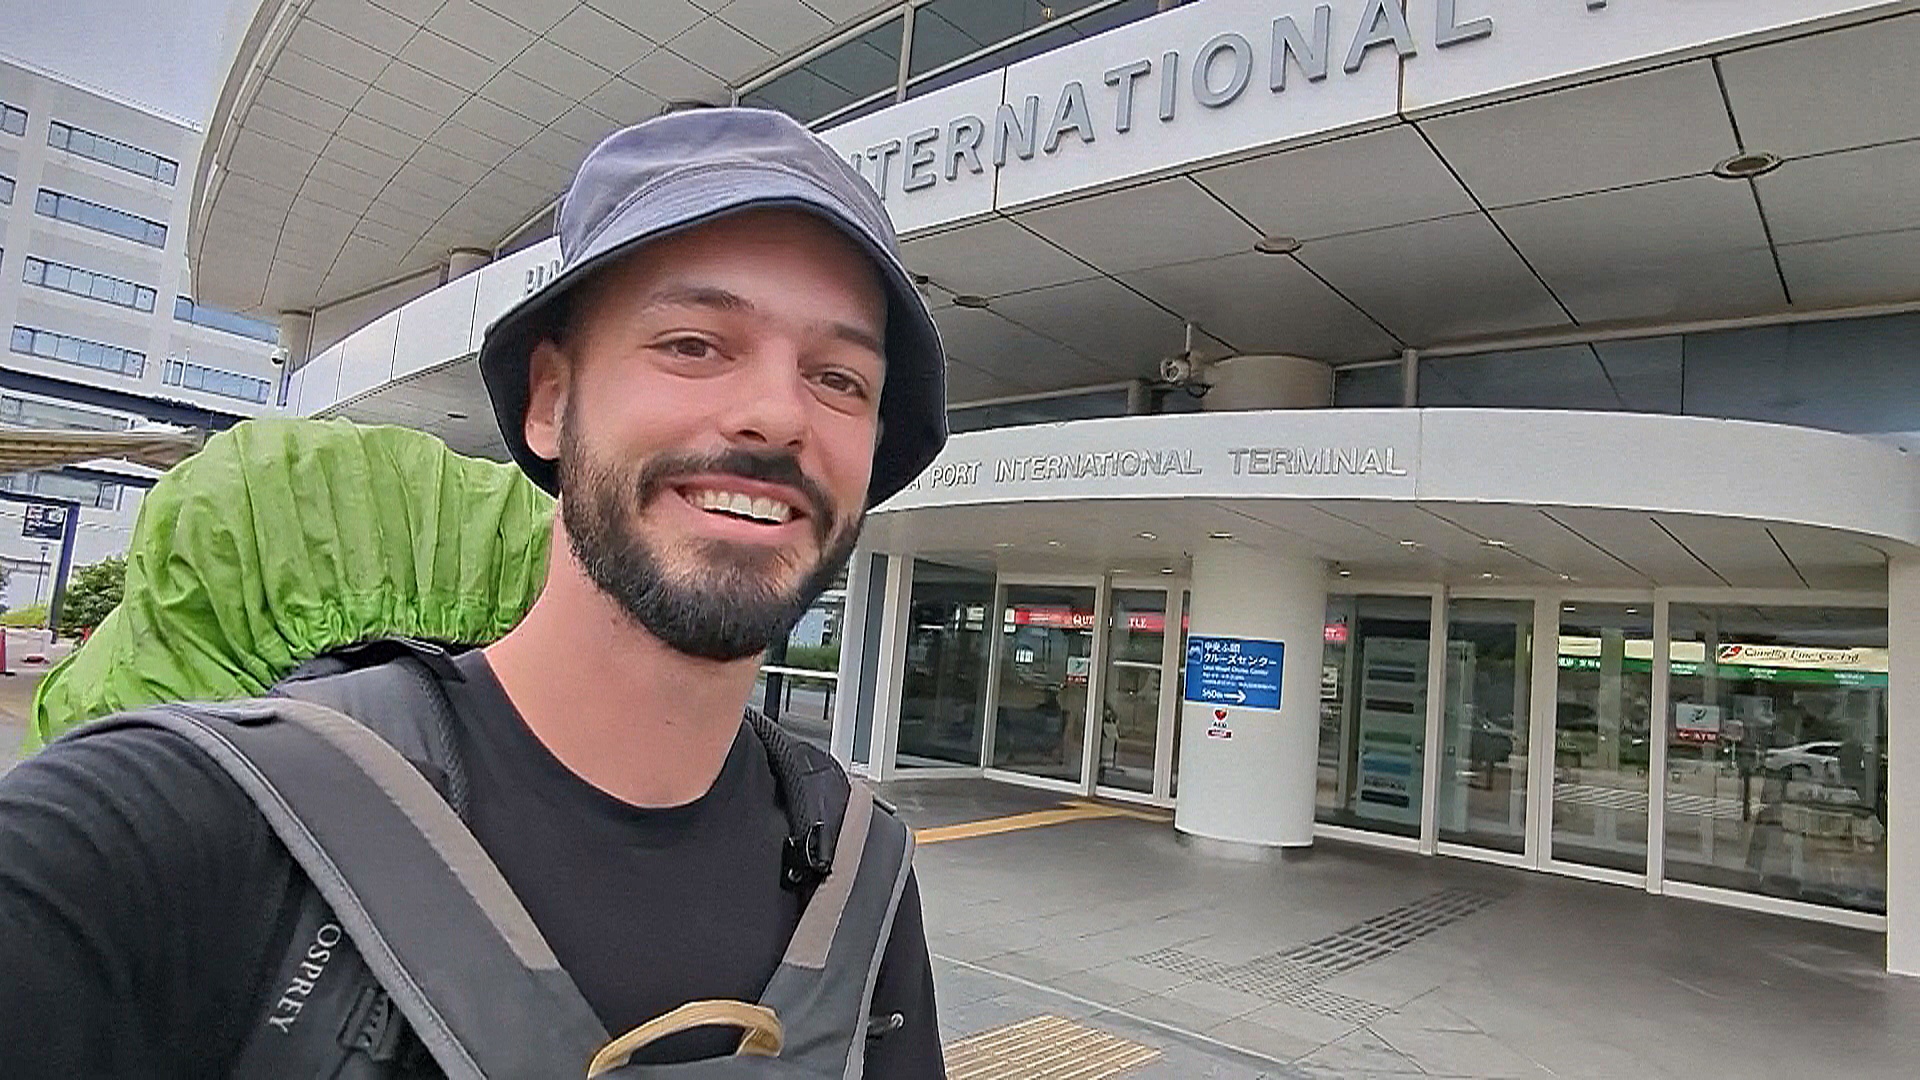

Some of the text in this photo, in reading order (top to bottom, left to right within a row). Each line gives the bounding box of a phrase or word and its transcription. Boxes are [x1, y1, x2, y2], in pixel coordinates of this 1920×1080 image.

[850, 0, 1493, 199] TERNATIONAL
[930, 461, 981, 489] PORT
[994, 449, 1202, 484] INTERNATIONAL
[1228, 445, 1407, 476] TERMINAL
[1203, 653, 1277, 667] クルーズセンター
[268, 923, 341, 1034] OSPREY
